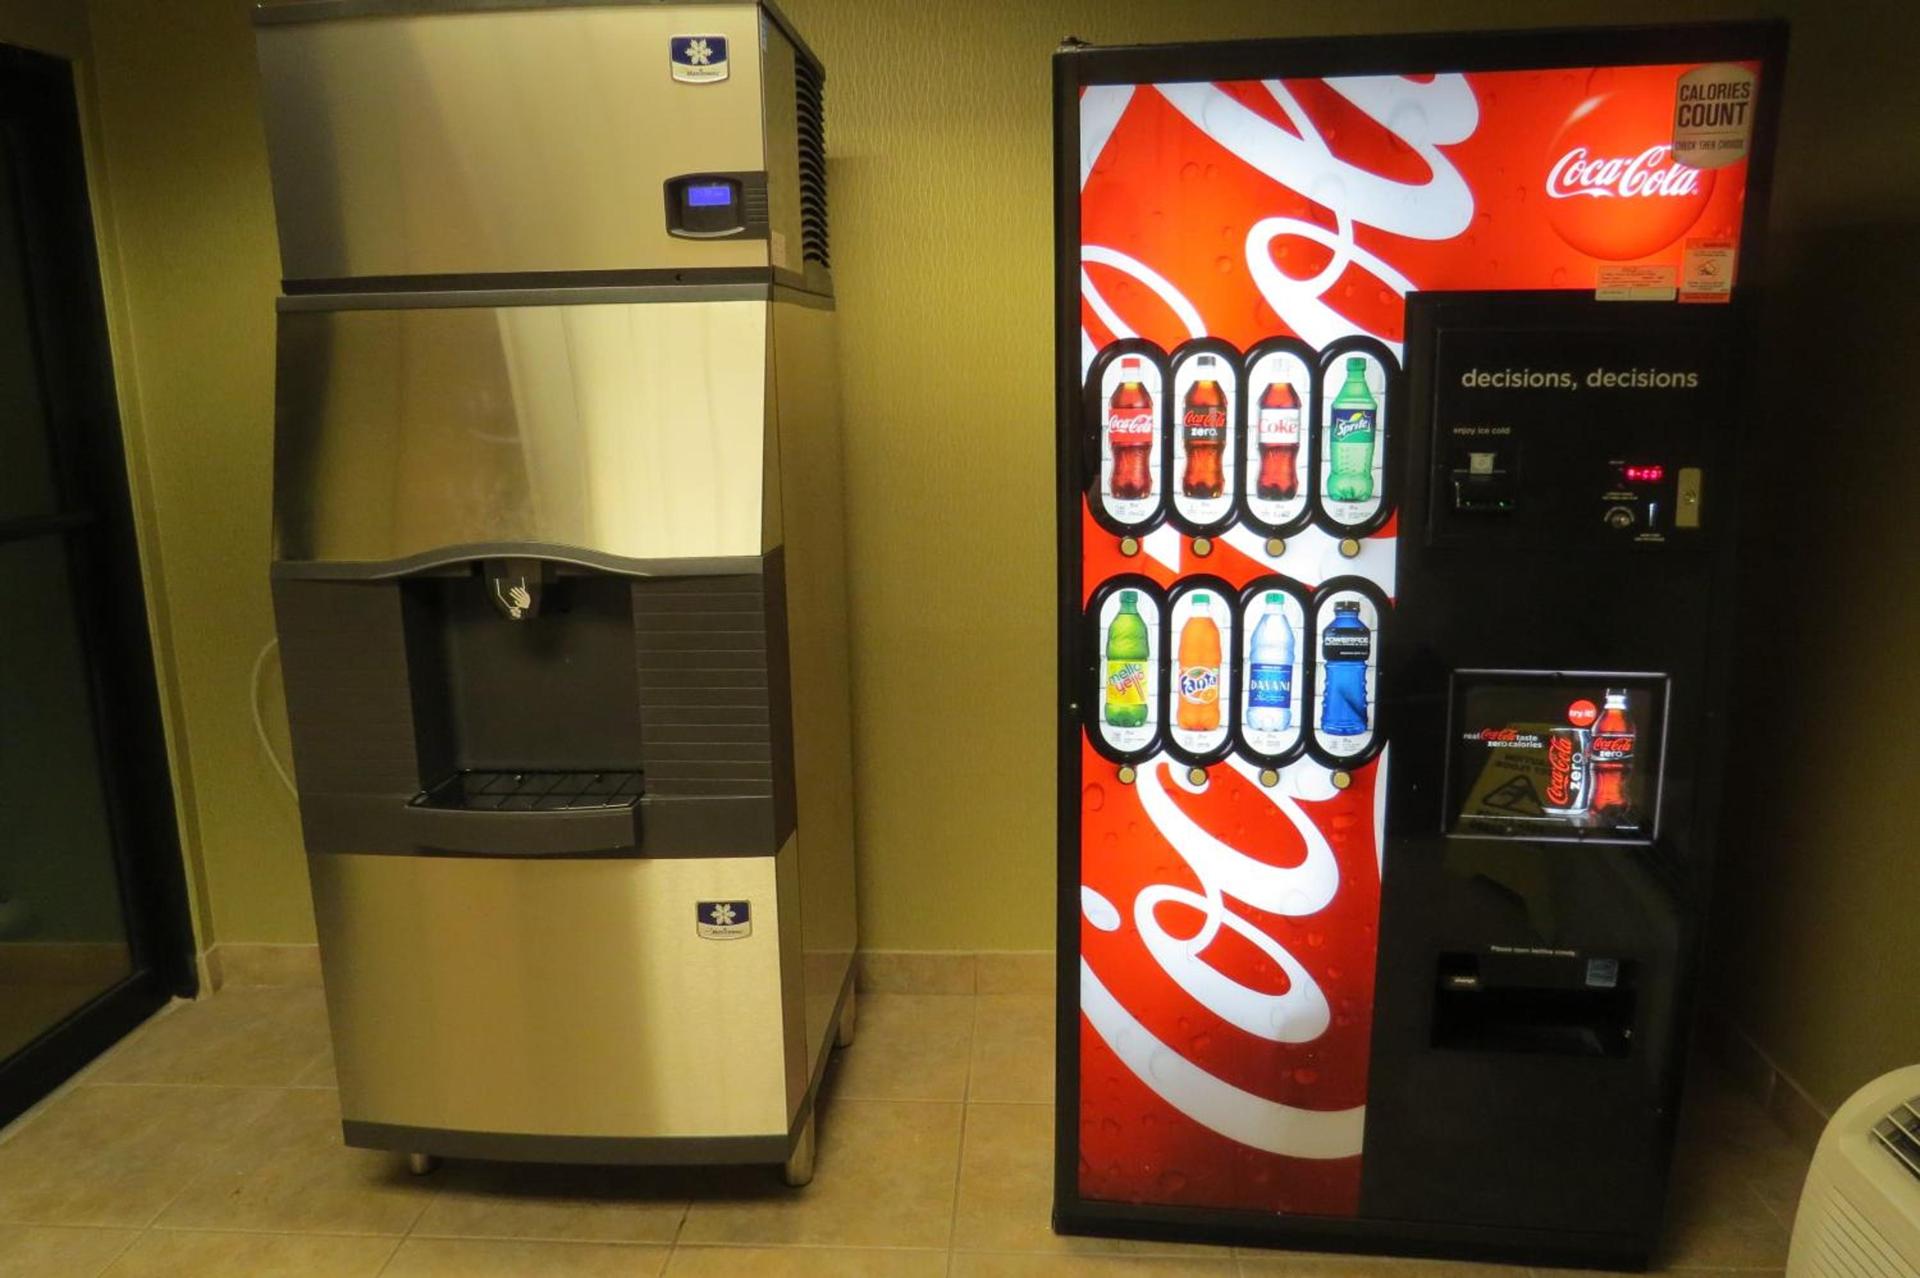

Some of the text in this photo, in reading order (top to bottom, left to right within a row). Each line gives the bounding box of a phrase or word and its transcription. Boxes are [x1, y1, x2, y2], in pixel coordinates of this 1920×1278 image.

[1680, 82, 1750, 101] CALORIES
[1678, 102, 1748, 127] COUNT
[1461, 368, 1699, 390] decisions, decisions
[1258, 419, 1298, 434] Coke
[1337, 418, 1371, 436] Sprite
[1453, 427, 1476, 435] enjoy
[1487, 740, 1542, 749] zero calories
[1516, 734, 1538, 742] taste
[1599, 750, 1623, 758] zero
[1570, 752, 1583, 791] zero
